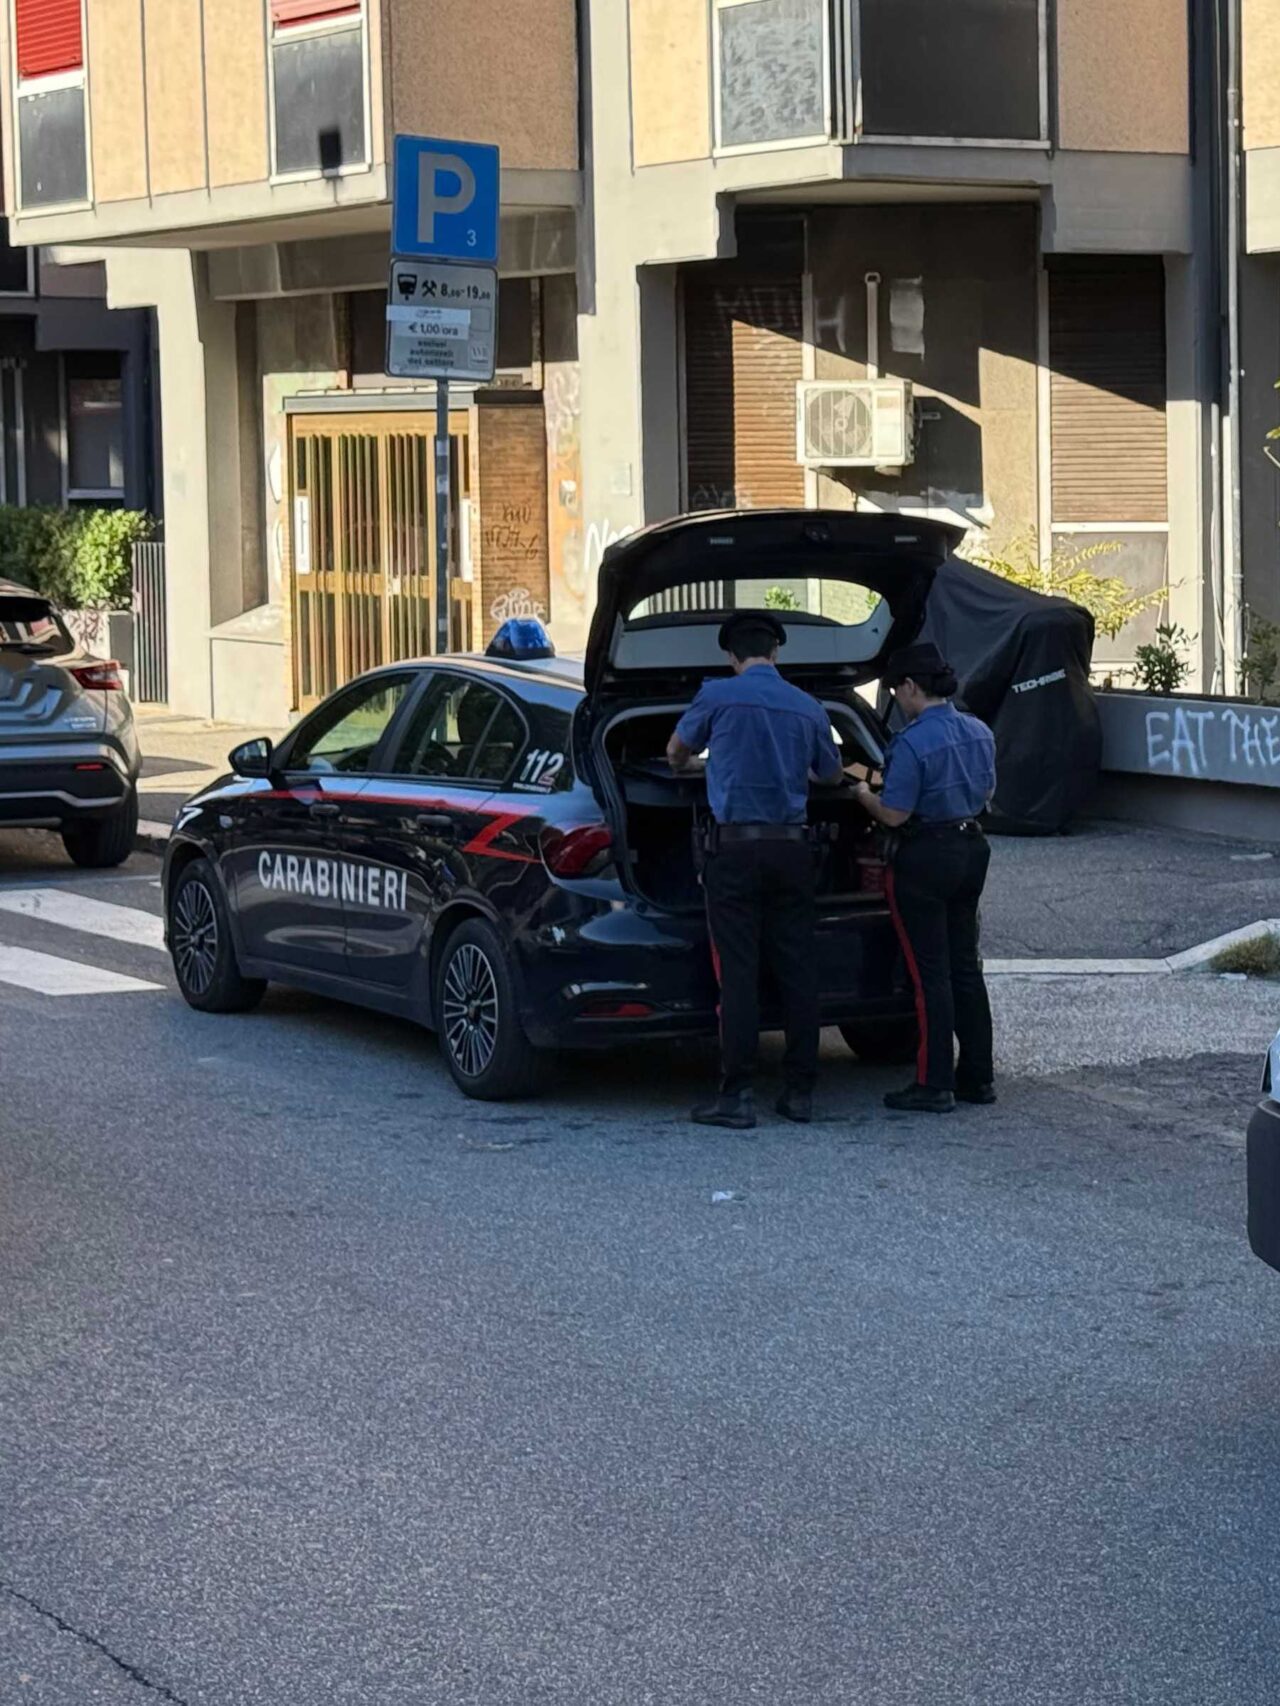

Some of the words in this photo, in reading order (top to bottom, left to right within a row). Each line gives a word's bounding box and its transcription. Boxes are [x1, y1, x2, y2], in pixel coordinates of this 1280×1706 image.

[417, 151, 477, 243] P
[466, 229, 478, 247] 3
[442, 328, 459, 336] ora
[1145, 707, 1215, 774] EAT
[520, 749, 564, 785] 112
[258, 850, 408, 911] CARABINIERI
